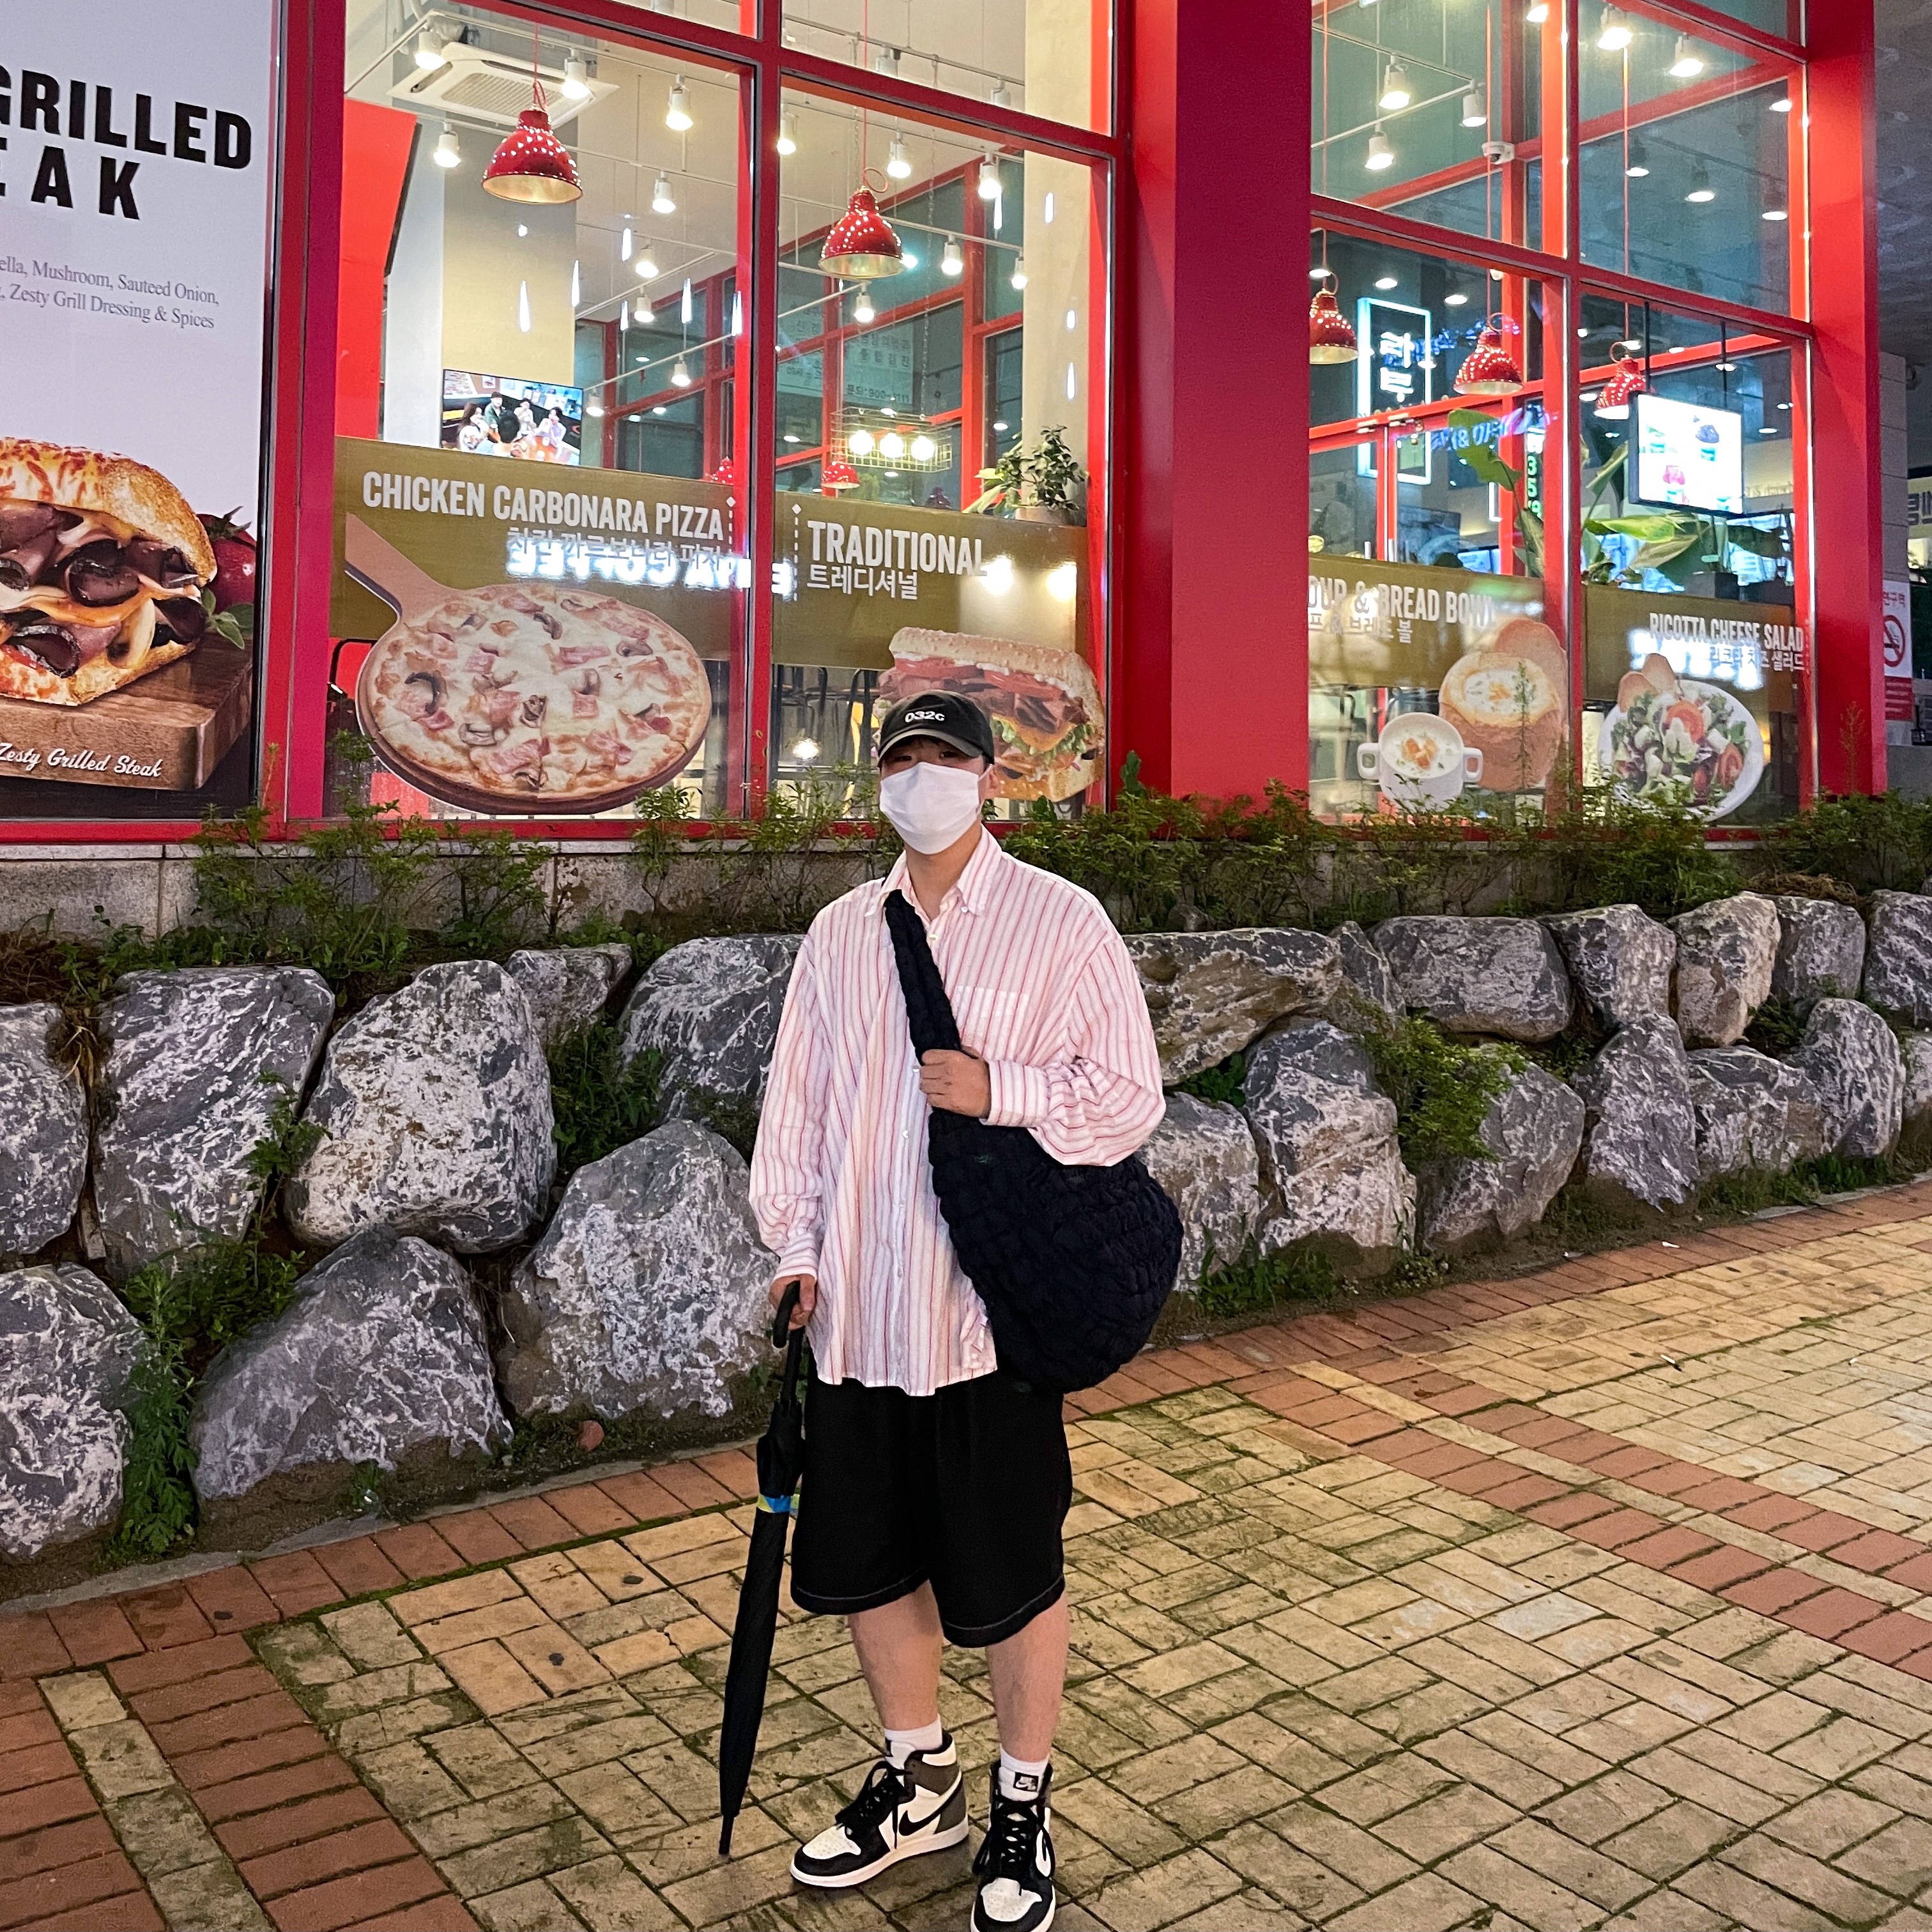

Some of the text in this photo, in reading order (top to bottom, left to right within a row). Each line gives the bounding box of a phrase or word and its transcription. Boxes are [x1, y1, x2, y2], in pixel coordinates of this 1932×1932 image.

[0, 136, 141, 220] AK
[33, 260, 114, 291] Mushroom,
[118, 274, 171, 297] Sauteed
[174, 283, 219, 305] Onion,
[10, 283, 50, 308] Zesty
[54, 290, 86, 310] Grill
[91, 295, 151, 323] Dressing
[155, 305, 168, 322] &
[171, 307, 215, 328] Spices
[363, 471, 723, 541] CHICKEN CARBONARA PIZZA
[806, 519, 988, 576] TRADITIONAL
[806, 564, 918, 601] 트레디셔널
[1354, 581, 1370, 614] &
[1377, 583, 1440, 622] BREAD
[1397, 619, 1413, 643] 볼
[1650, 613, 1804, 652] RICOTTA CHEESE SALAD
[1771, 650, 1805, 672] 샐러드
[47, 747, 112, 772] Grilled
[114, 755, 164, 778] Steak
